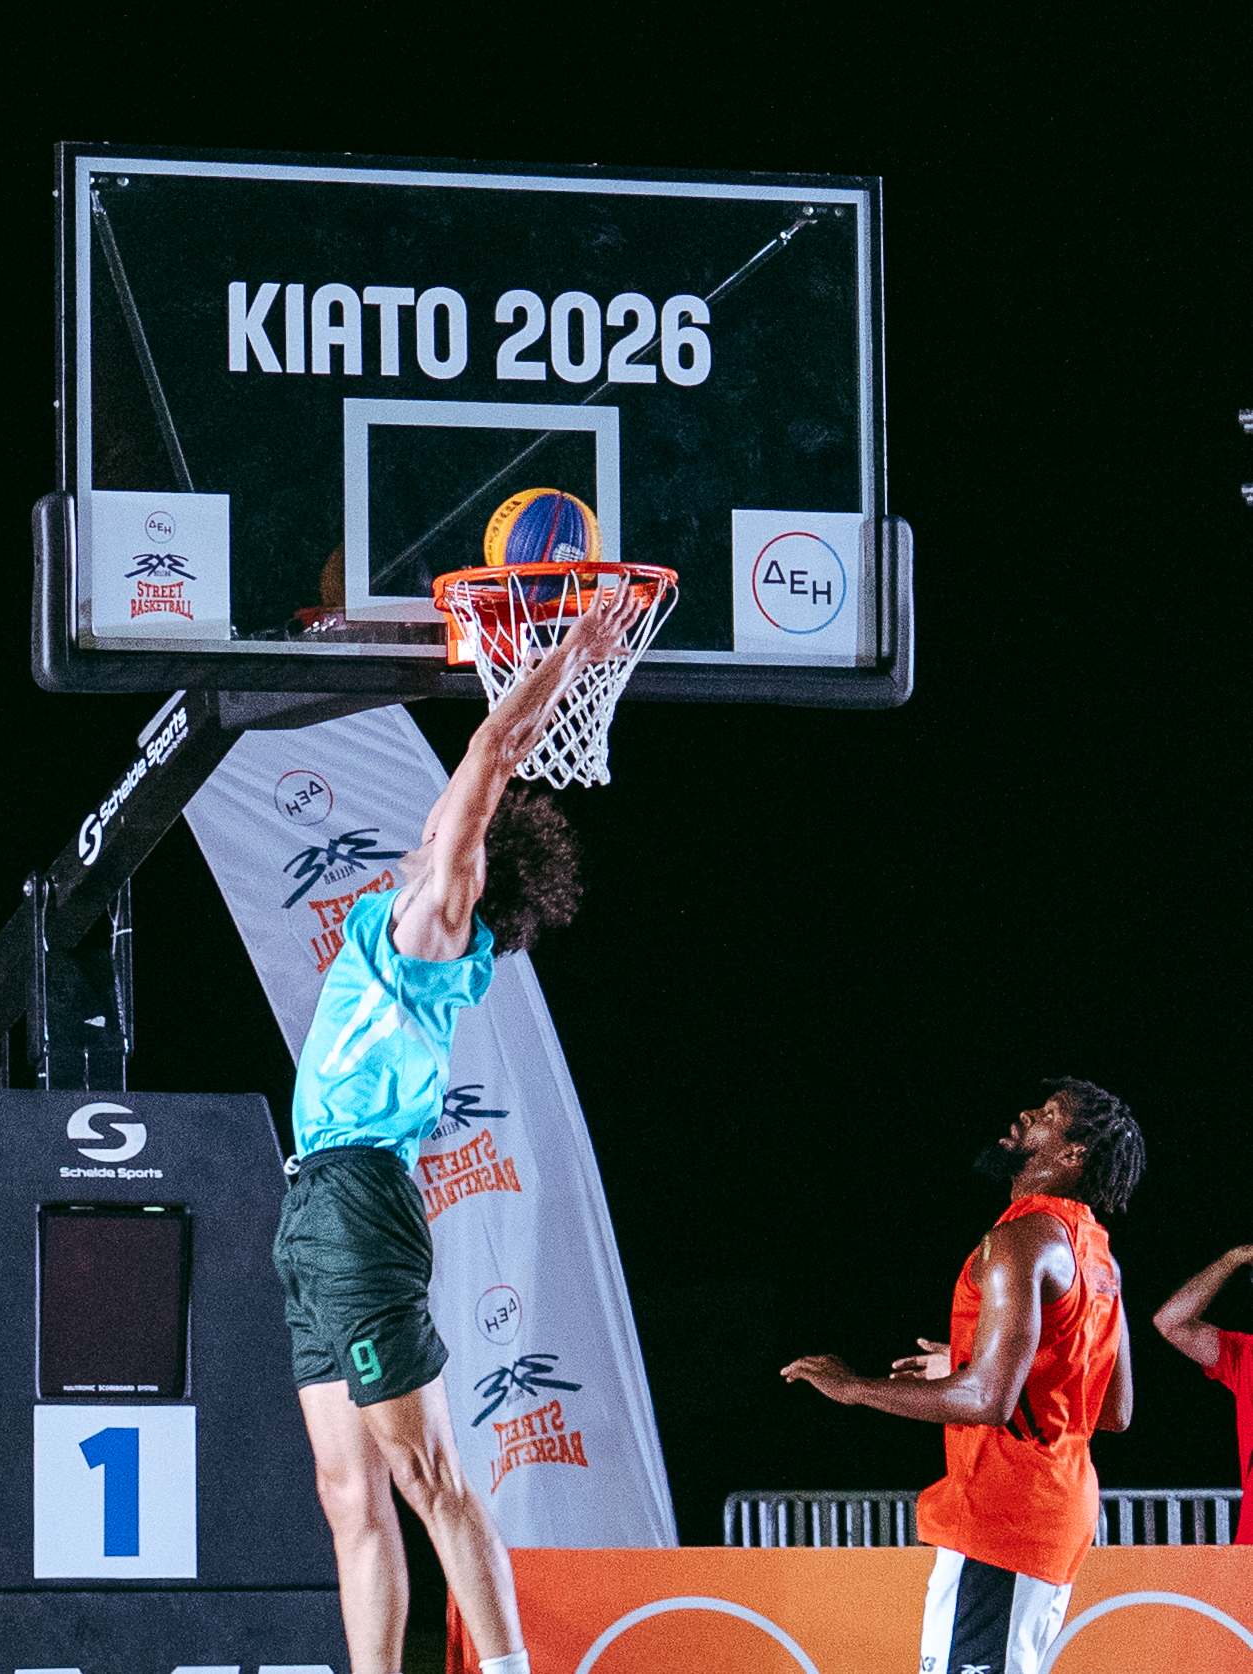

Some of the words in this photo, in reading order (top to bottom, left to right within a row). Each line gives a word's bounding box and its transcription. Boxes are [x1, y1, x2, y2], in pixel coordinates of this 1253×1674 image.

[228, 281, 468, 380] KIATO
[495, 289, 712, 386] 2026
[130, 598, 195, 621] BASKETBALL
[137, 580, 184, 599] STREET
[99, 758, 147, 828] Schelde
[146, 707, 187, 768] Sports
[59, 1166, 116, 1179] Schelde
[117, 1167, 164, 1180] Sports
[350, 1339, 383, 1386] 9
[79, 1427, 140, 1557] 1
